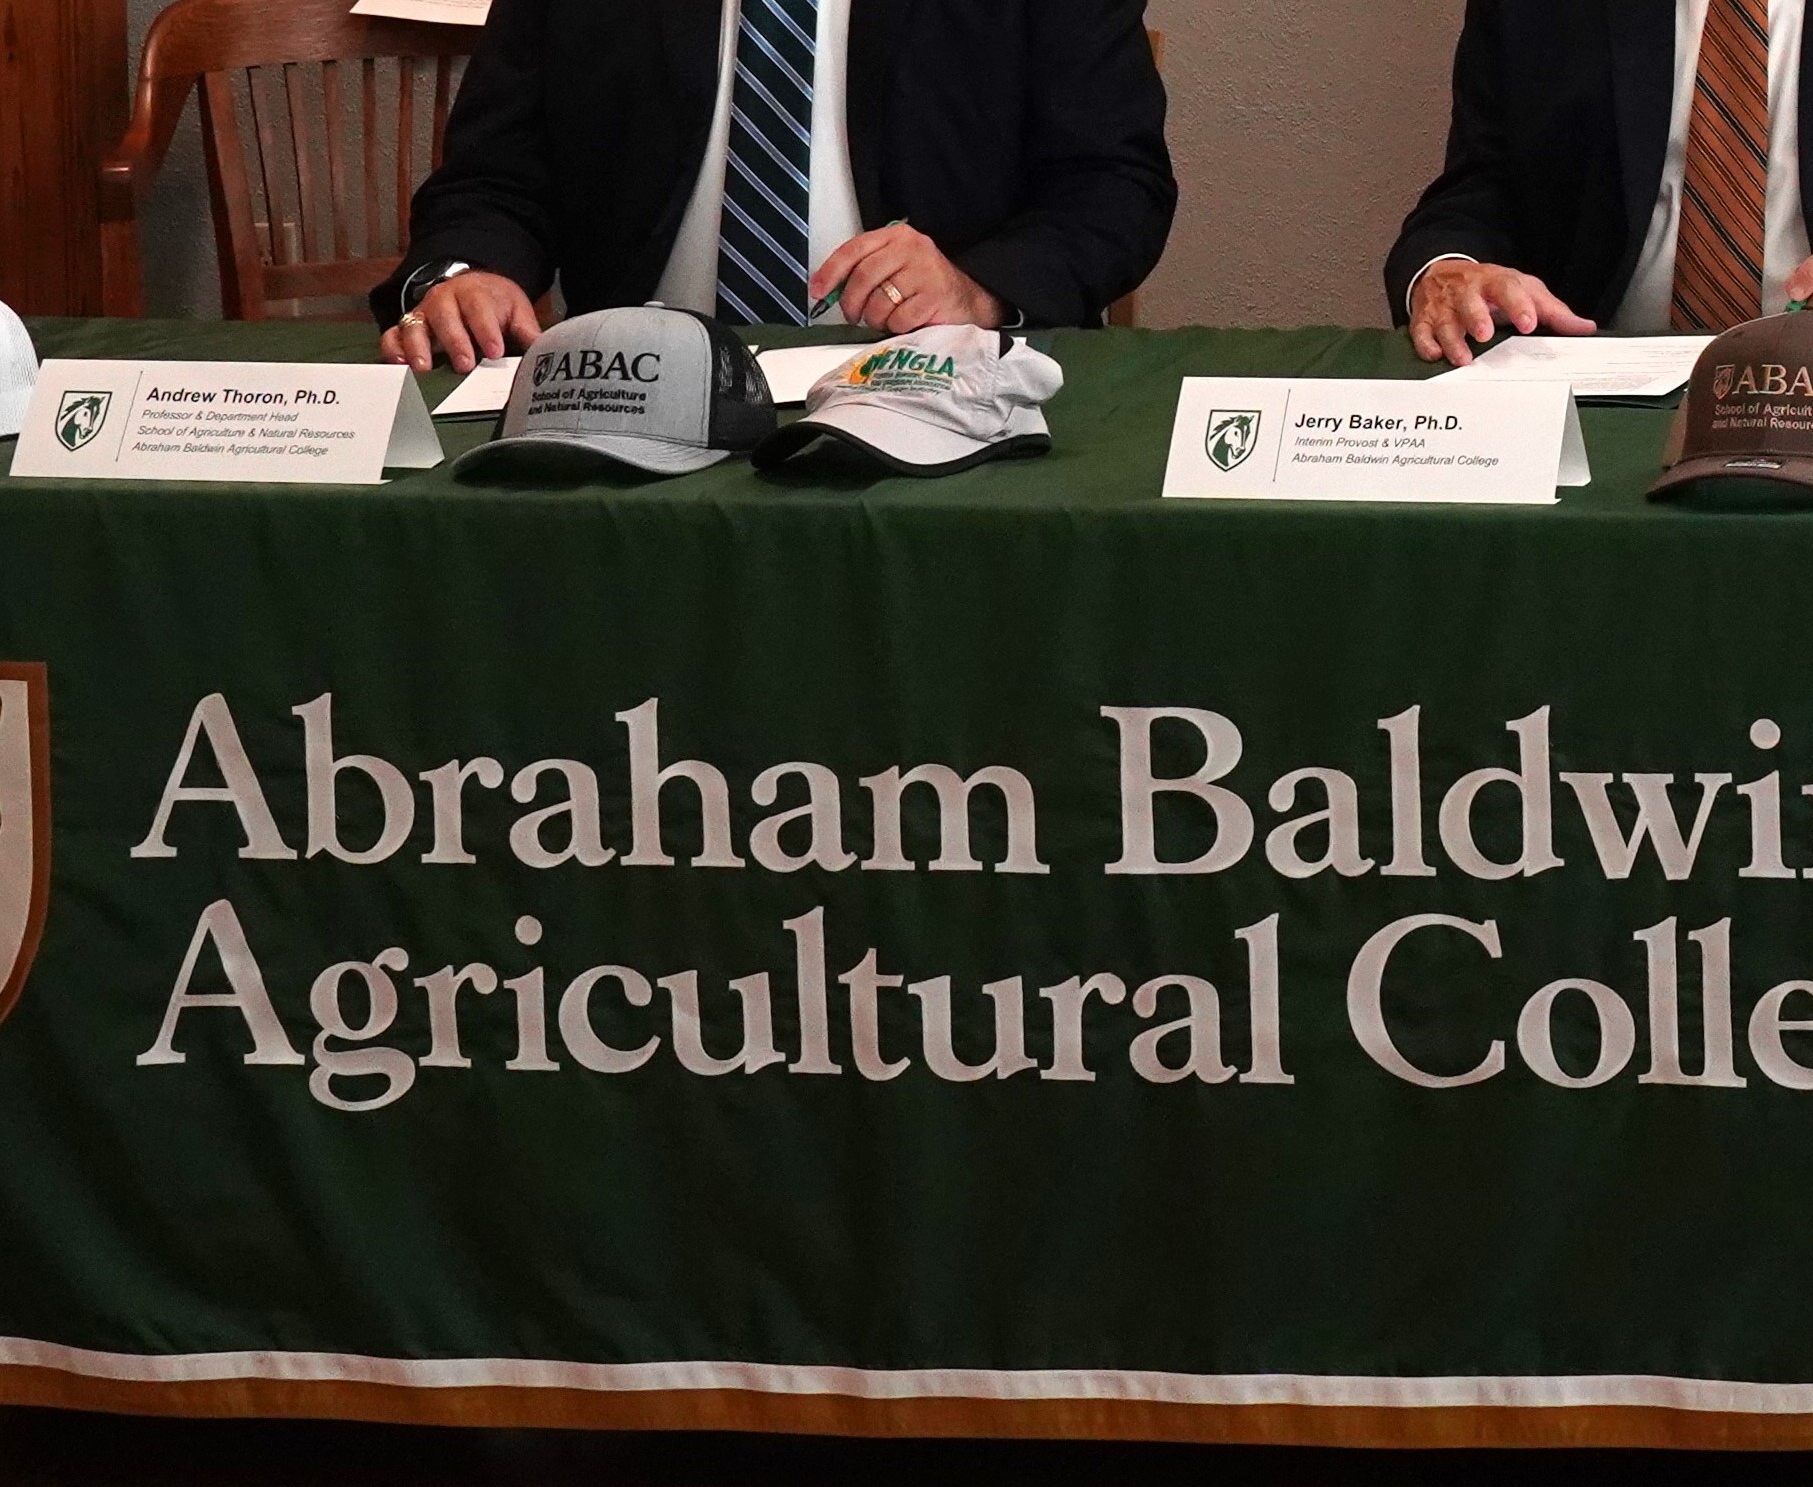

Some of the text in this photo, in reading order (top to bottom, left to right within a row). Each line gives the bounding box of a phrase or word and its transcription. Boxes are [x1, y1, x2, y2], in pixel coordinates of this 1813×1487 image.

[550, 350, 660, 382] ABAC
[146, 387, 340, 406] Andrew Thoron, Ph.D.
[532, 388, 646, 402] School of Agriculture
[544, 401, 580, 413] Natural
[583, 402, 645, 415] Resources
[1715, 403, 1745, 416] School
[1748, 402, 1759, 413] of
[142, 409, 299, 423] Professor & Department Head
[1730, 417, 1767, 429] Natural
[1295, 414, 1463, 433] Jerry Baker, Ph.D.
[138, 425, 355, 439] School of Agriculture & Natural Resources
[132, 441, 329, 457] Abraham Baldwin Agricultural College
[1295, 437, 1426, 449] Interim Provost & VPAA
[1292, 453, 1500, 468] Abraham Baldwin Agricultural College
[131, 692, 1050, 874] Abraham
[136, 898, 1295, 1112] Agricultural
